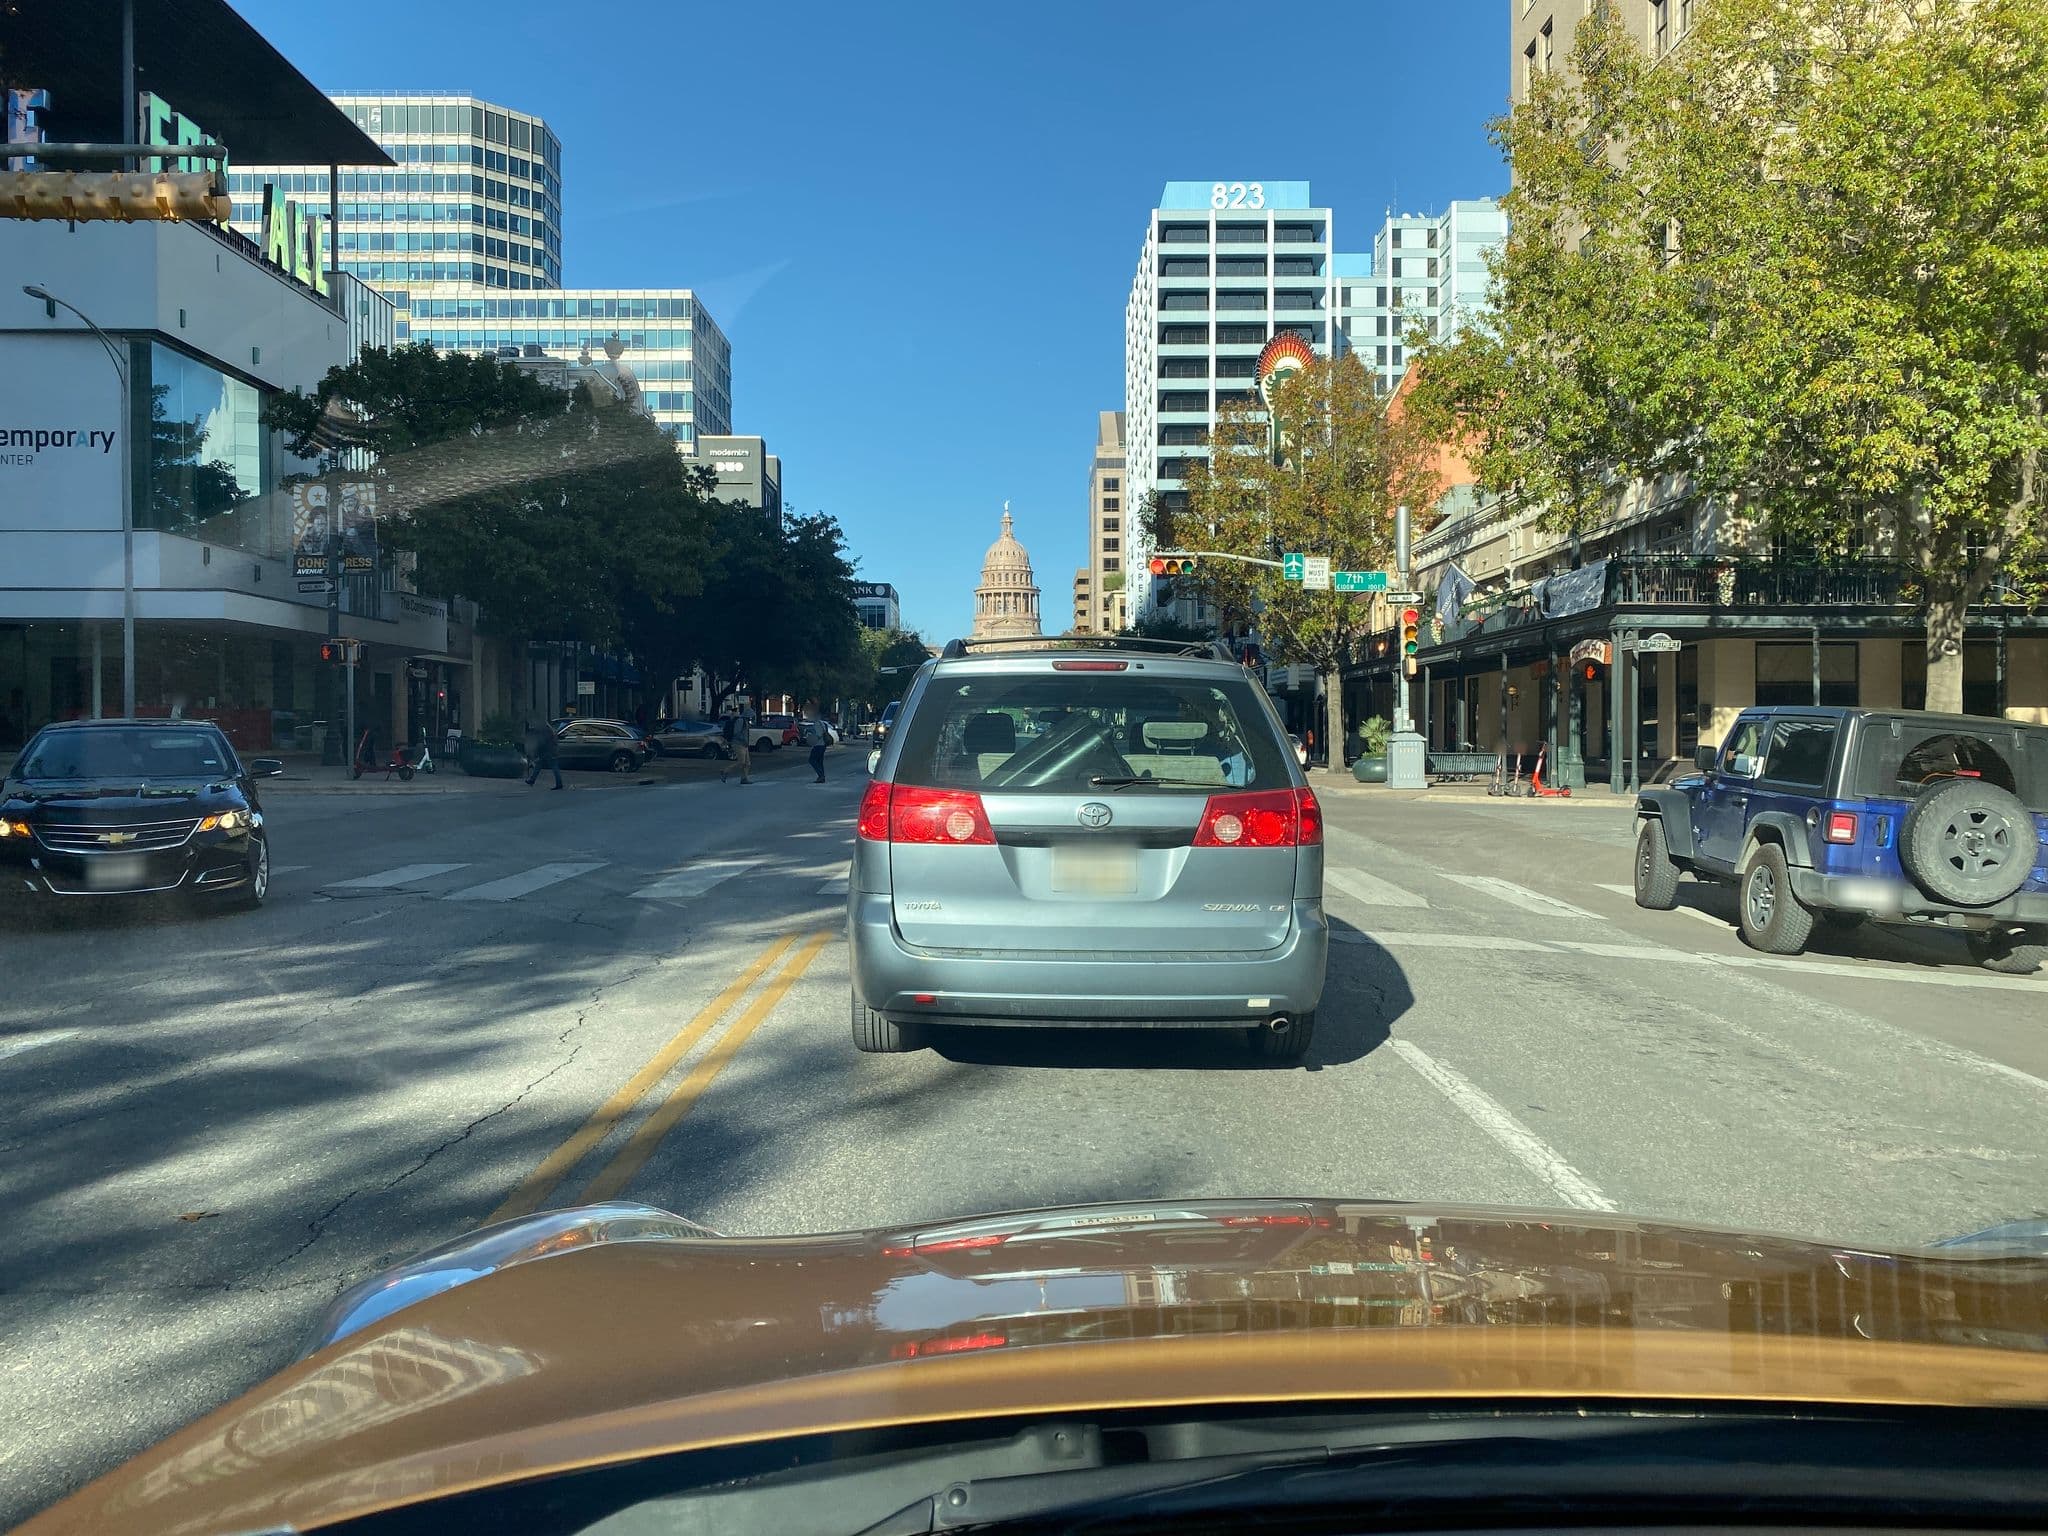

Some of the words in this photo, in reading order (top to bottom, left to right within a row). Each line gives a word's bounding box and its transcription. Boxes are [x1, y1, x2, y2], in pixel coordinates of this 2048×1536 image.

[1211, 182, 1265, 209] 823
[262, 183, 329, 298] ALL
[0, 454, 34, 465] NTER
[715, 461, 744, 472] DUO
[1345, 573, 1364, 583] 7th
[852, 586, 872, 594] ANK
[904, 902, 943, 911] TOYOTA
[1200, 903, 1262, 912] SIENNA
